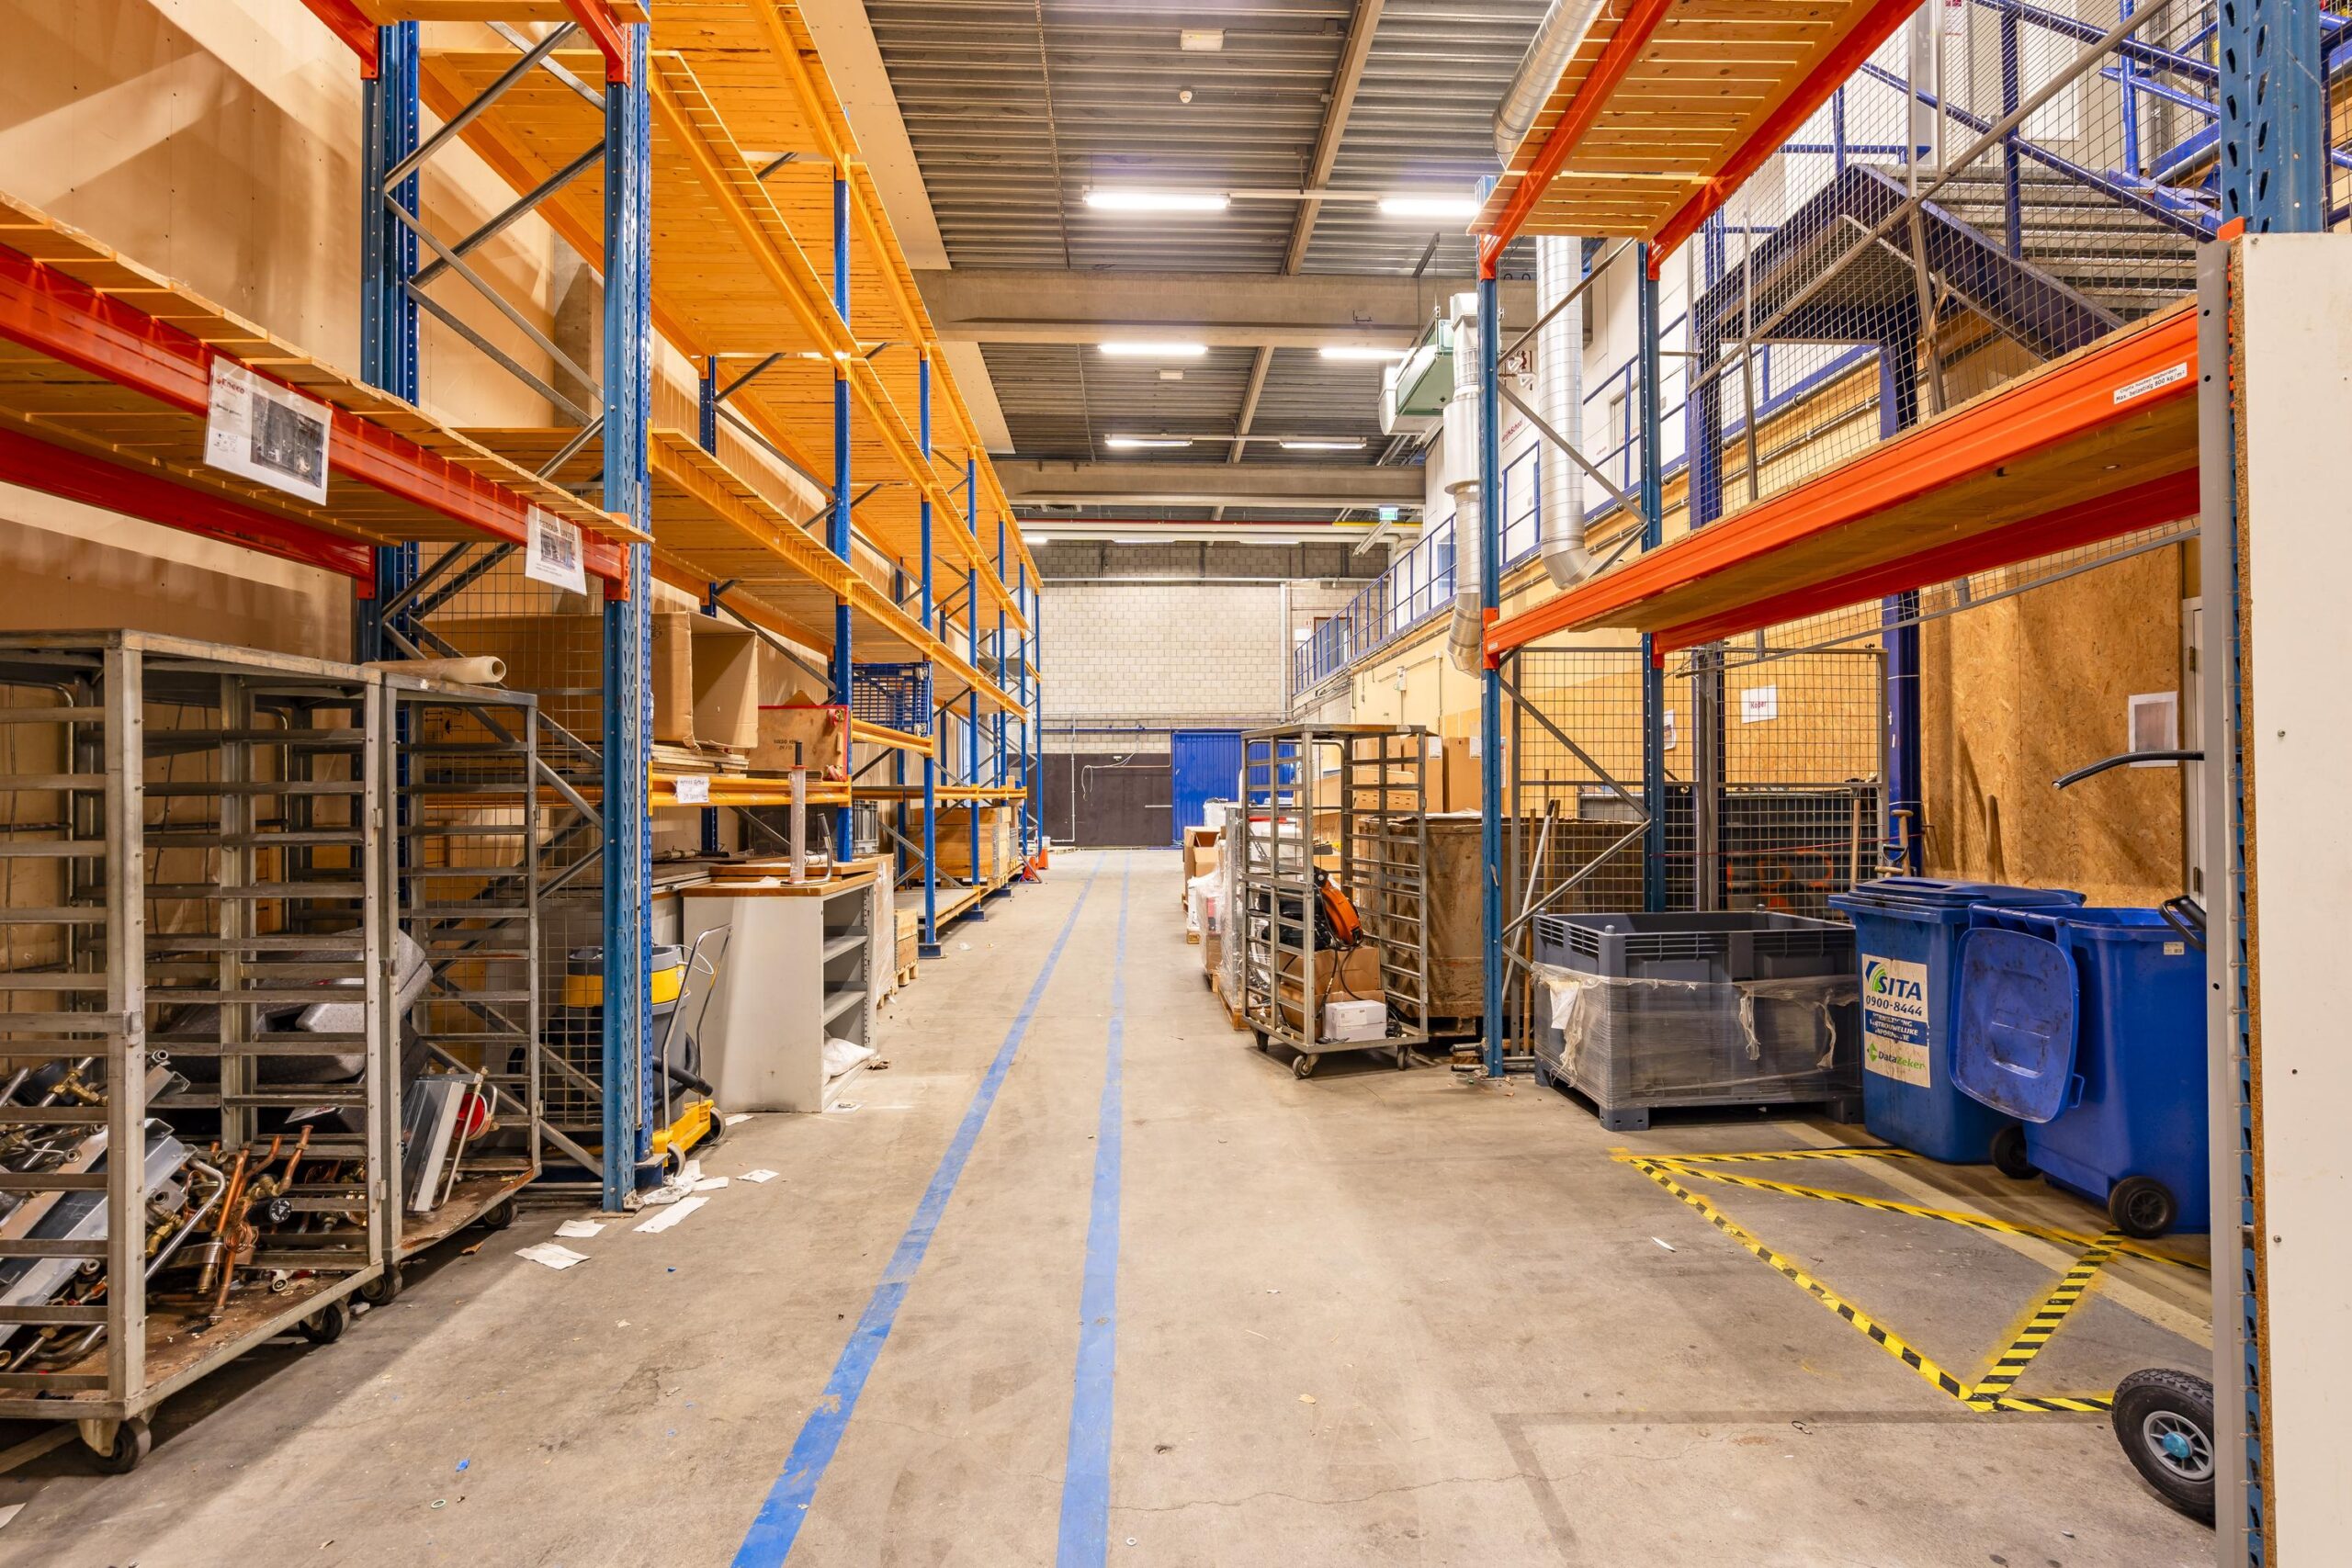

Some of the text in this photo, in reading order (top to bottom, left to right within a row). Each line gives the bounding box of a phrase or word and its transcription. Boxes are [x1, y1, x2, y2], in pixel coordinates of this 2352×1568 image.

[221, 378, 245, 395] Eneco
[2154, 378, 2165, 387] 800
[1878, 976, 1922, 1001] SITA
[1866, 995, 1922, 1017] 0900-8444
[1878, 1050, 1926, 1070] DataZeker
